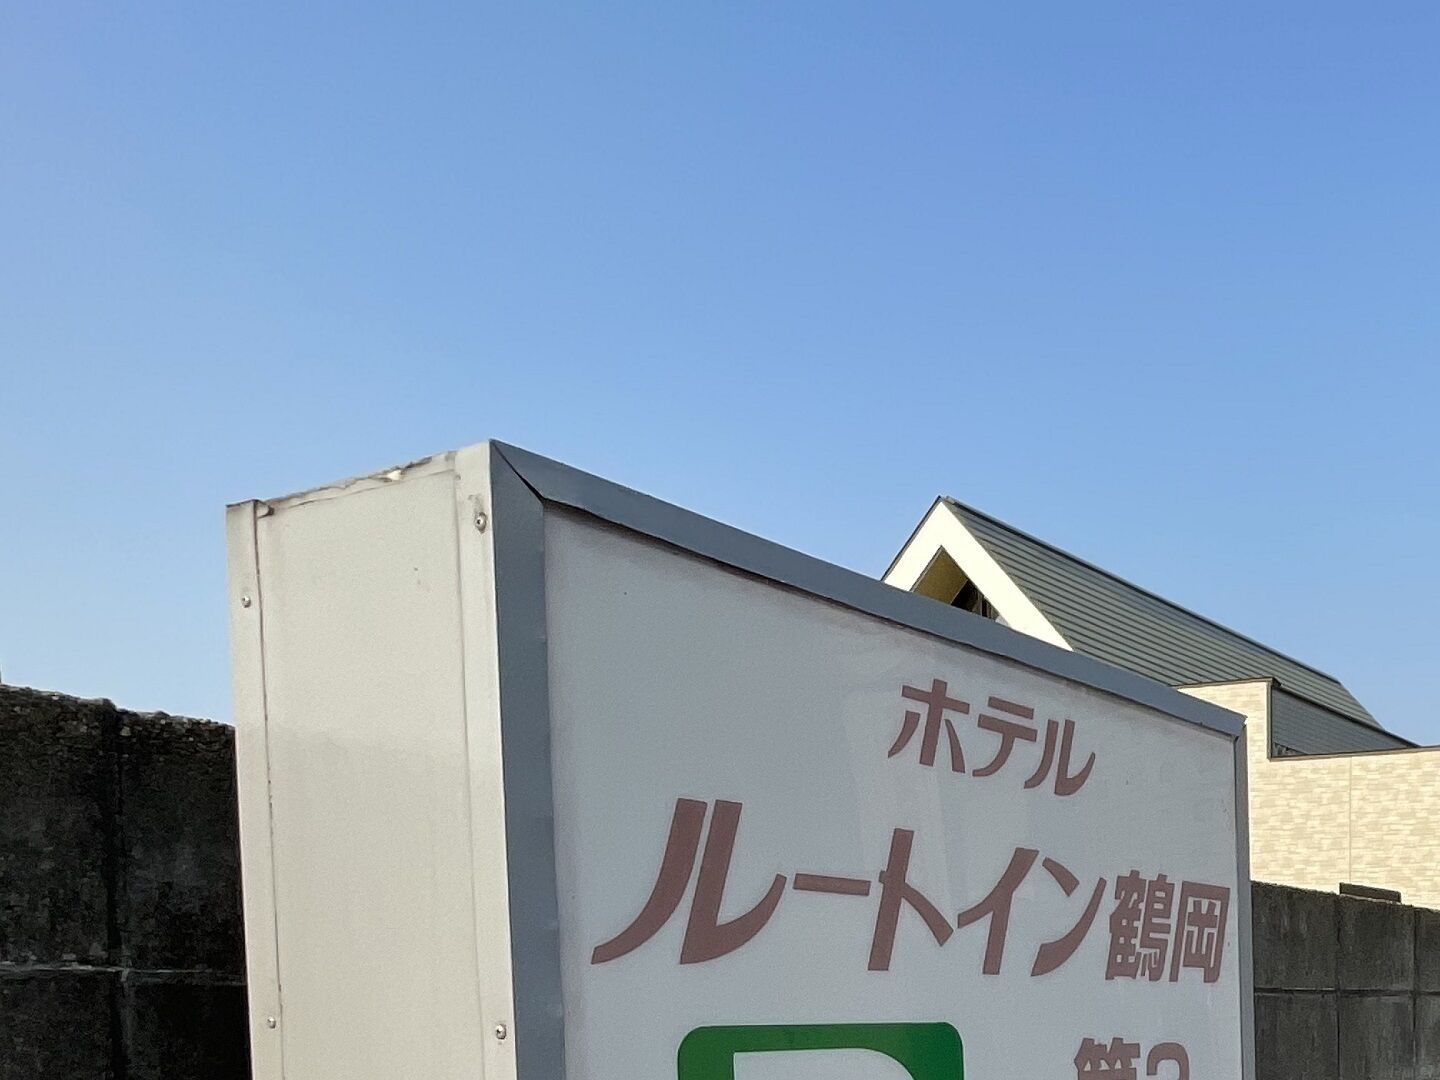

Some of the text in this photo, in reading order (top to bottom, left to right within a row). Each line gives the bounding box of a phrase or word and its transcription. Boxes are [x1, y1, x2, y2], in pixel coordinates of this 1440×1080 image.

[888, 678, 1096, 797] ホテル
[591, 797, 1231, 984] ルートイン鶴岡
